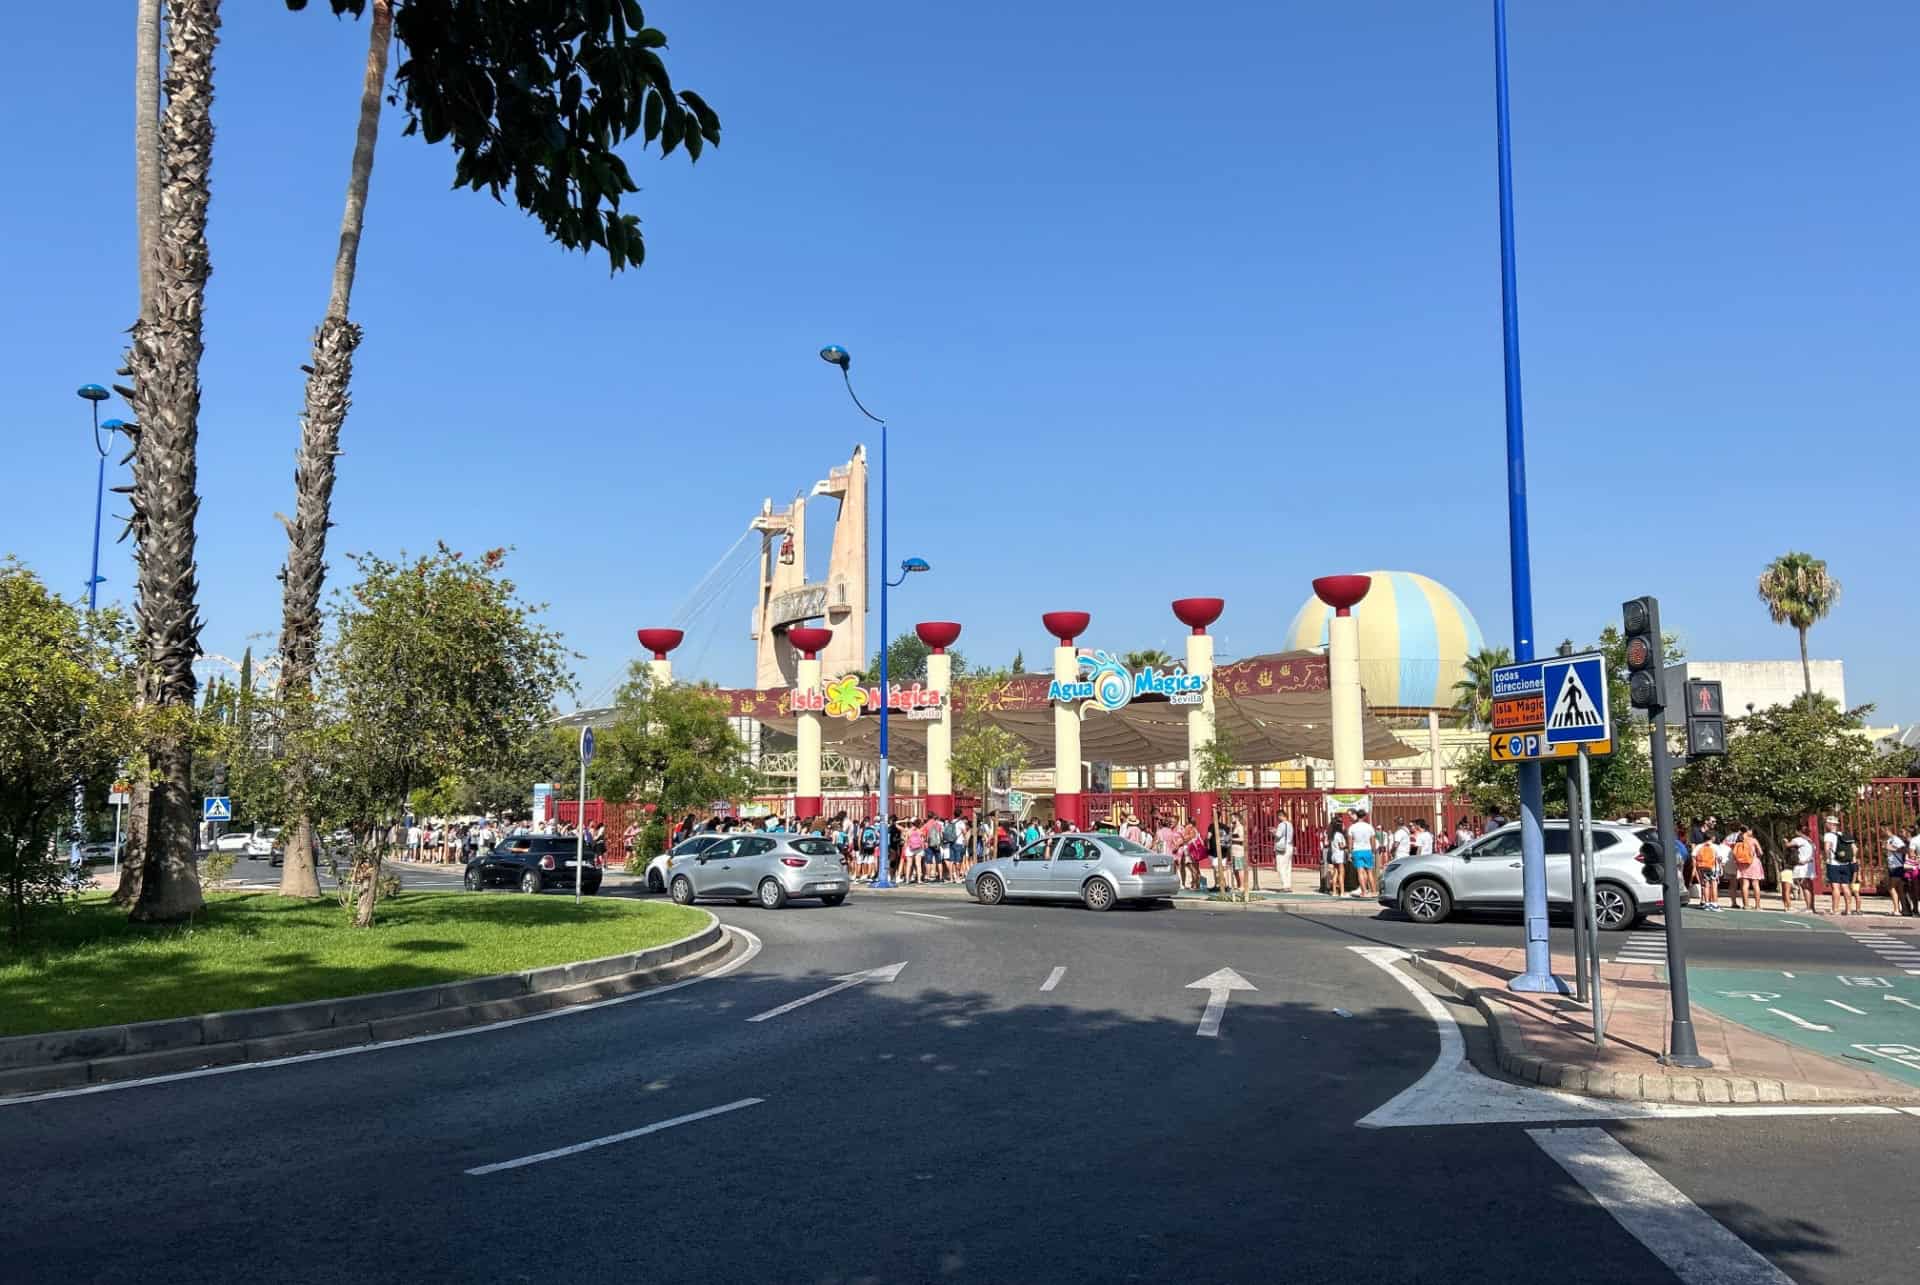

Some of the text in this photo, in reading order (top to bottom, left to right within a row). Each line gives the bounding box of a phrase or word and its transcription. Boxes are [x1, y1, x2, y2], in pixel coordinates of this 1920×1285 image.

[1495, 671, 1520, 682] todas
[1049, 666, 1202, 702] Agua Mágica
[1495, 679, 1544, 693] direcciones
[791, 682, 941, 711] Isla Mágica
[1170, 694, 1203, 704] Sevilla
[1516, 698, 1544, 713] Mágic
[907, 708, 942, 720] Sevilla
